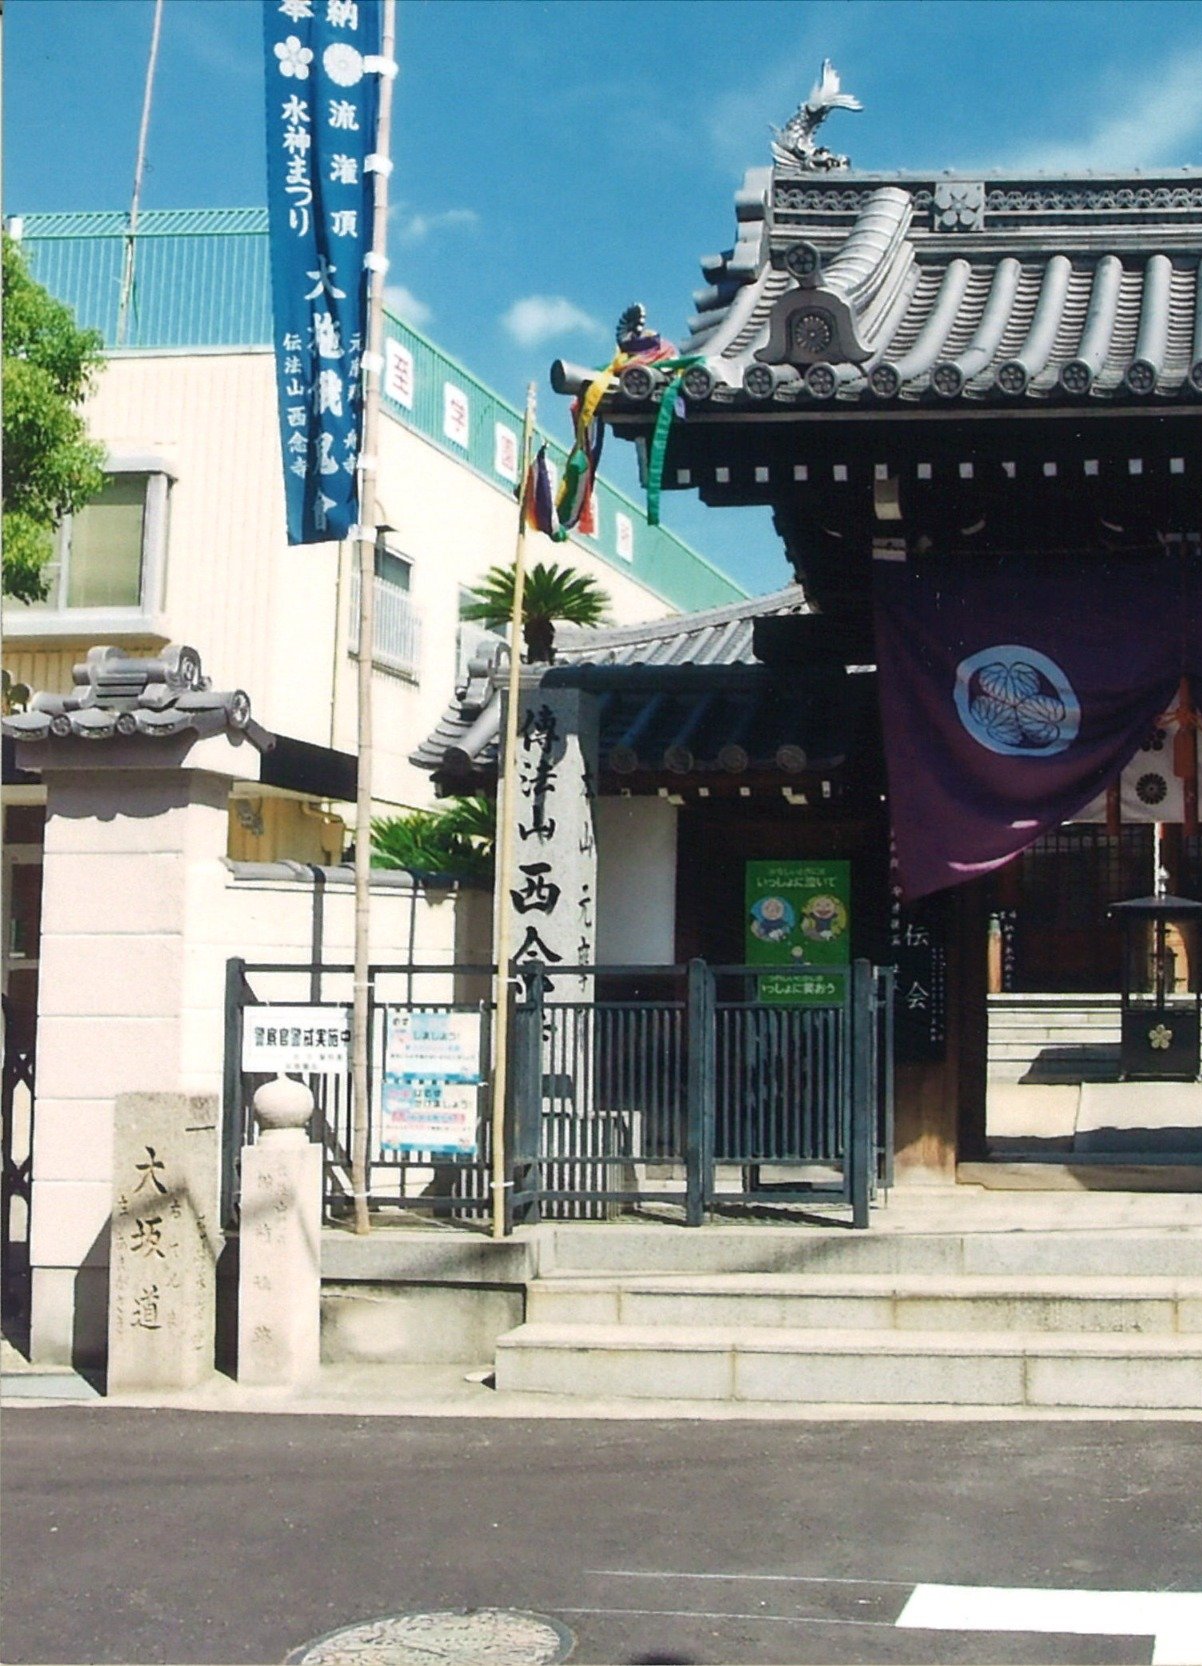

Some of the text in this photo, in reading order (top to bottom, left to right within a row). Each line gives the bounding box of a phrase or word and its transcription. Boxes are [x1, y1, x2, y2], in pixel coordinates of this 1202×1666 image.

[281, 94, 313, 237] 水神まつり
[282, 332, 308, 480] 伝法山西念寺
[130, 1145, 168, 1331] 大坂道
